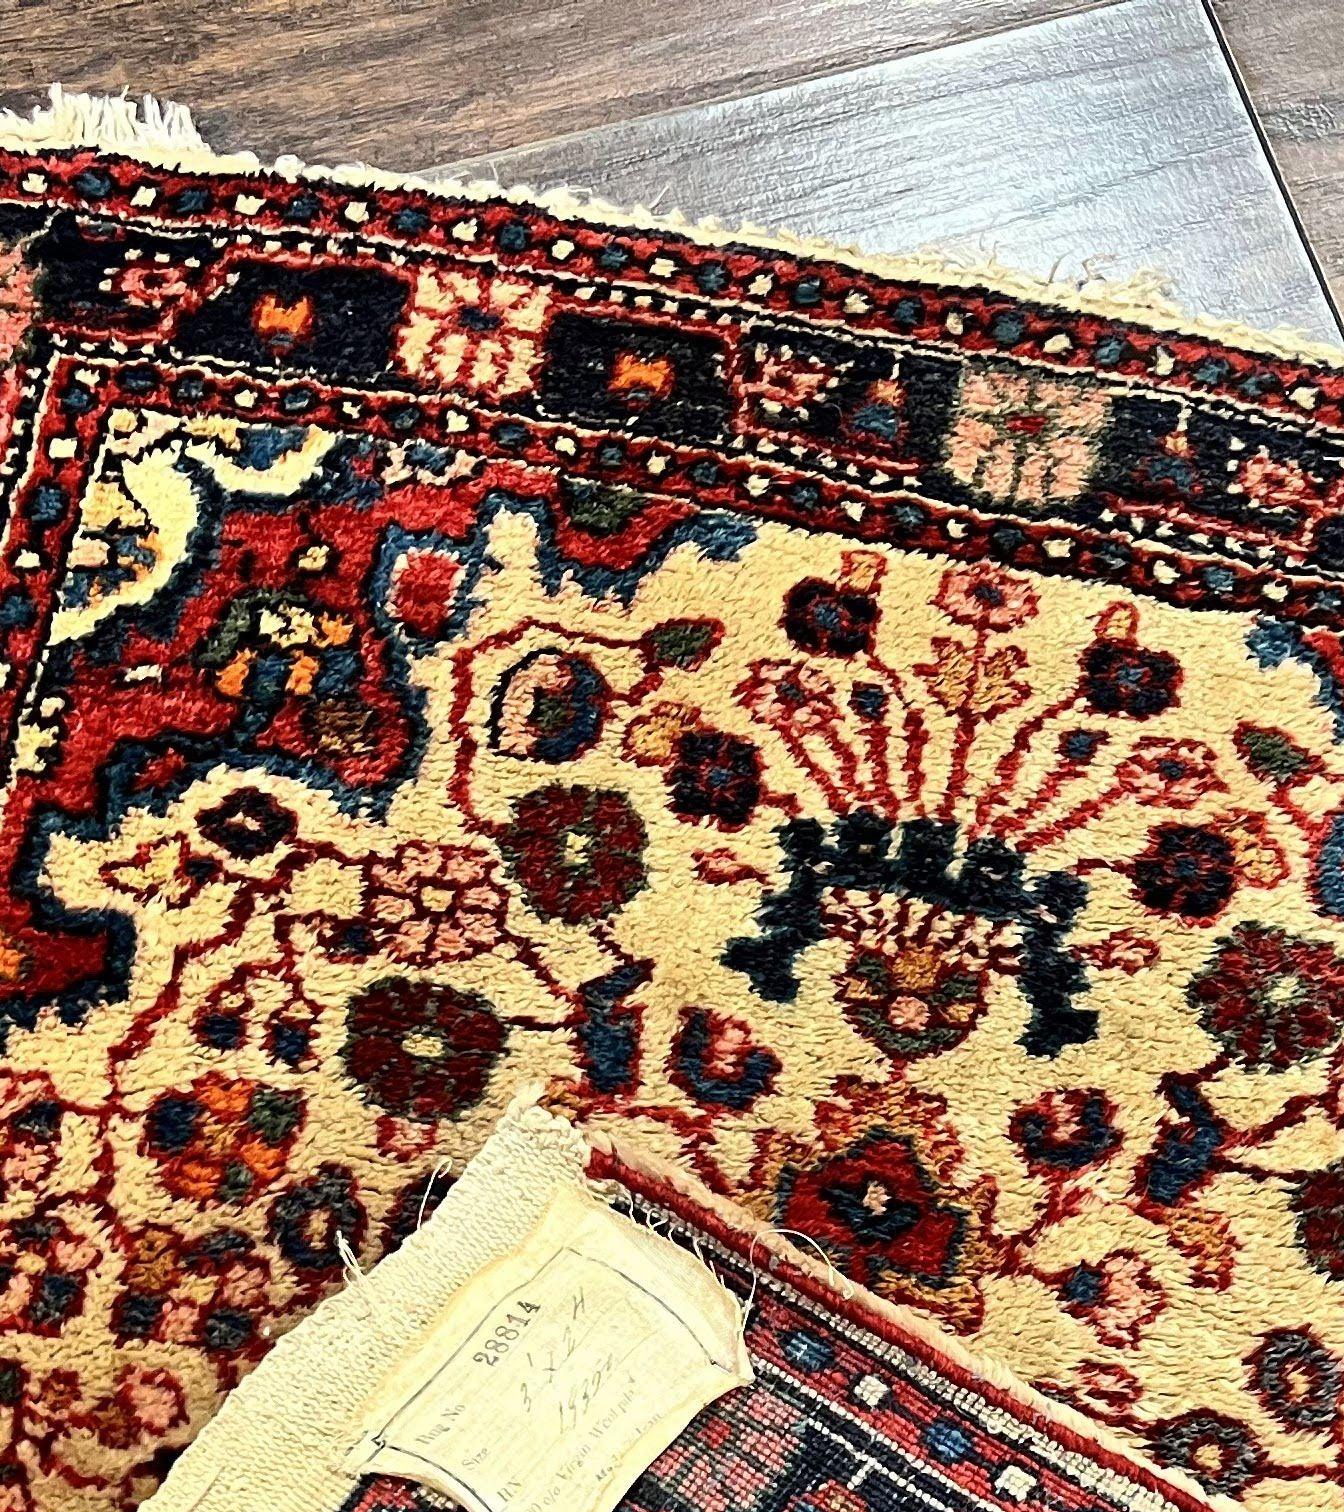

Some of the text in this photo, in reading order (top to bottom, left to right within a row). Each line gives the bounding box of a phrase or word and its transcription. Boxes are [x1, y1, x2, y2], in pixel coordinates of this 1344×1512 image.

[440, 1403, 467, 1422] No
[472, 1300, 541, 1366] 28814
[462, 1447, 490, 1471] Size
